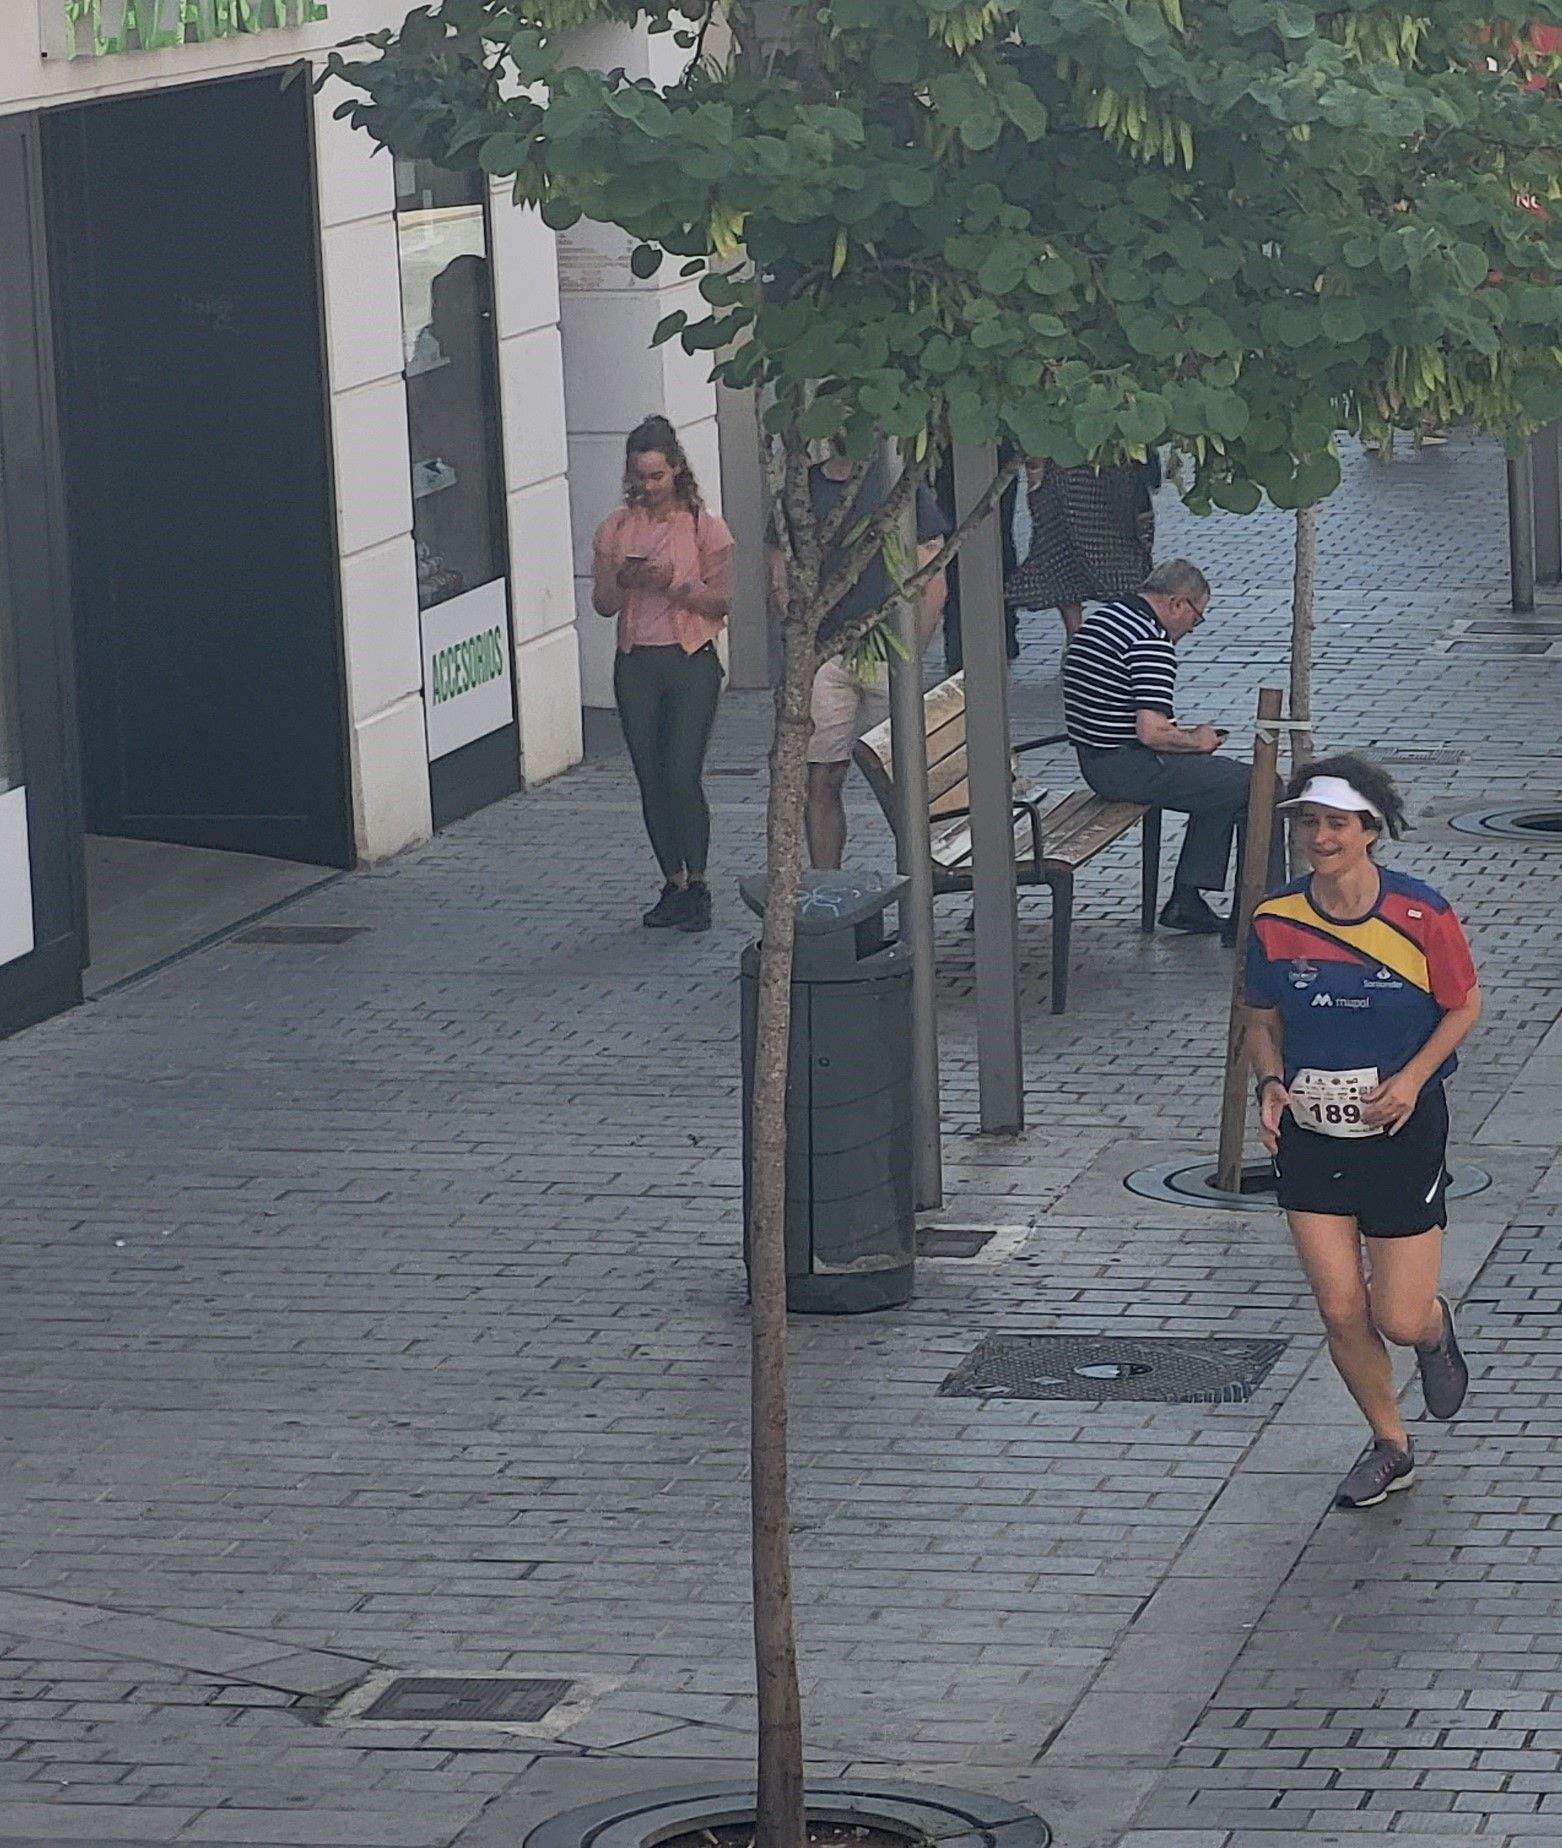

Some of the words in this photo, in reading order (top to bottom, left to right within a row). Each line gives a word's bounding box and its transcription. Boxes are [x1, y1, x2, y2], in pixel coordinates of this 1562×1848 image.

[431, 624, 503, 707] ACCESORIOS
[1335, 996, 1370, 1009] mupol
[1309, 1102, 1361, 1124] 189
